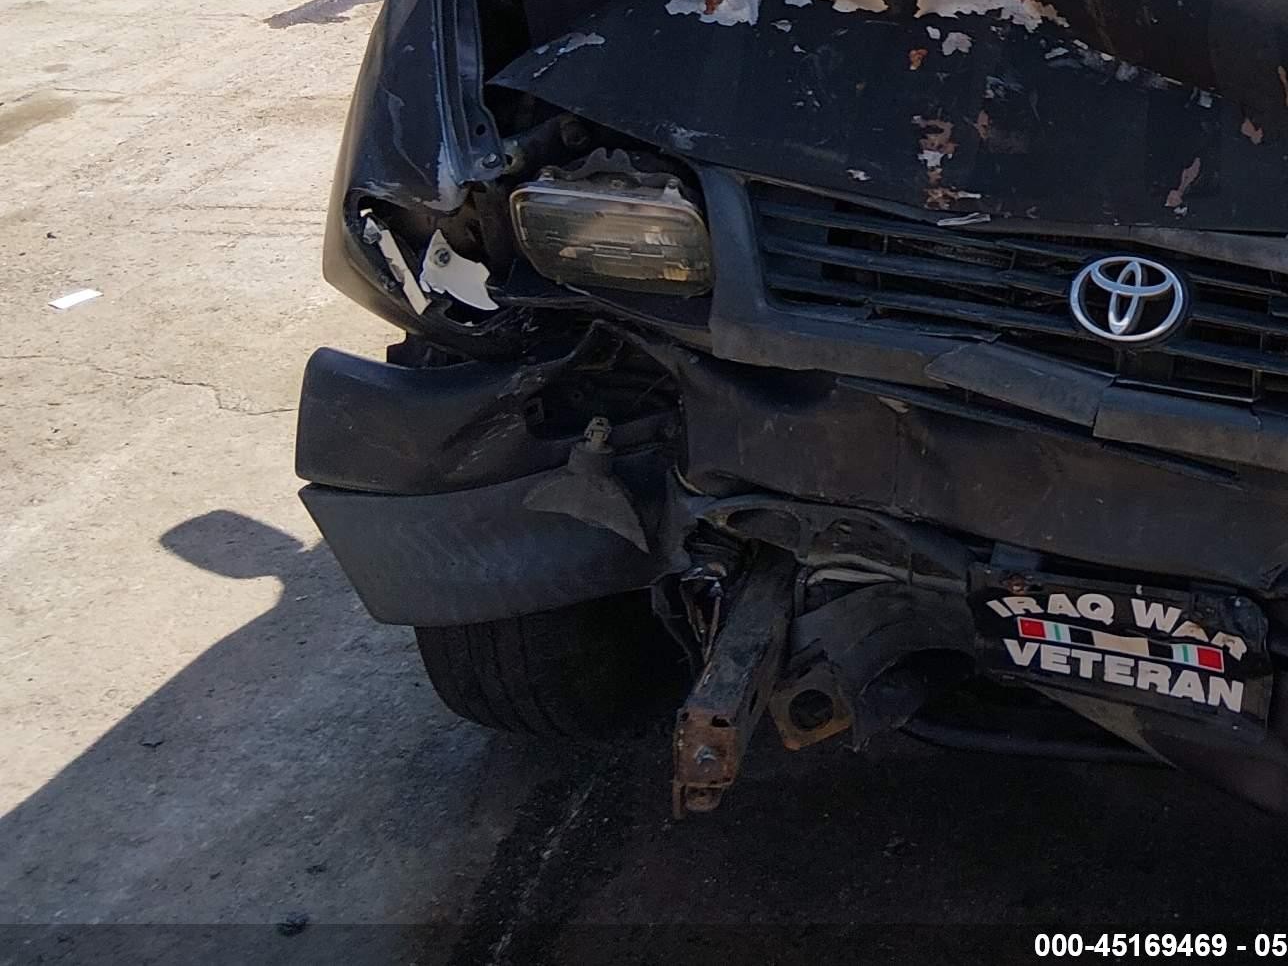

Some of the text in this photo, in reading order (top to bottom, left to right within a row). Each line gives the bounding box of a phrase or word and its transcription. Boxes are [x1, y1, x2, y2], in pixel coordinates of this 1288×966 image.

[986, 593, 1248, 661] IRAQ WAR
[1002, 638, 1244, 713] VETERAN
